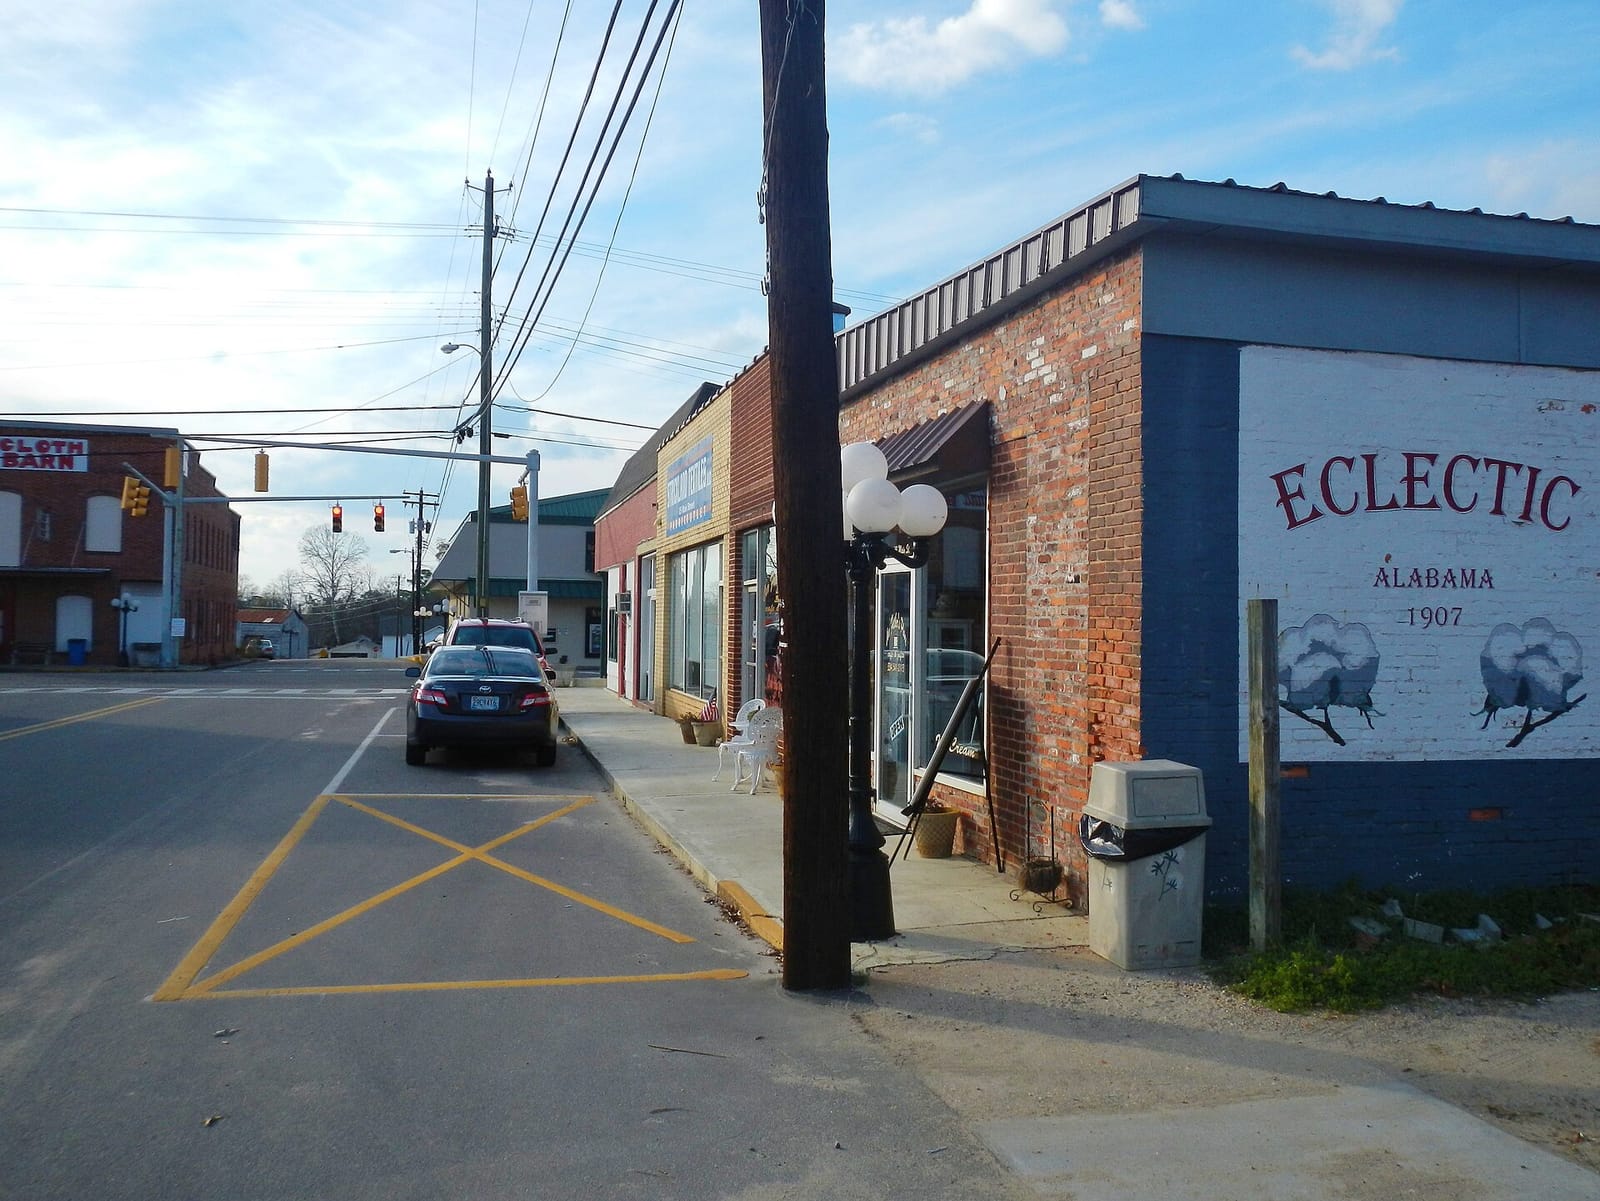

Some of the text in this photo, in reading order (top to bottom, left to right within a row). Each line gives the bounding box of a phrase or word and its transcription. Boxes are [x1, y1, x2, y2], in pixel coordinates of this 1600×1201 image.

[0, 438, 83, 454] CLOTH
[3, 452, 74, 470] BARN
[1269, 452, 1582, 532] ECLECTIC
[1373, 566, 1495, 589] ALABAMA
[1407, 606, 1463, 629] 1907
[890, 717, 904, 738] OPEN
[949, 737, 977, 759] Cream
